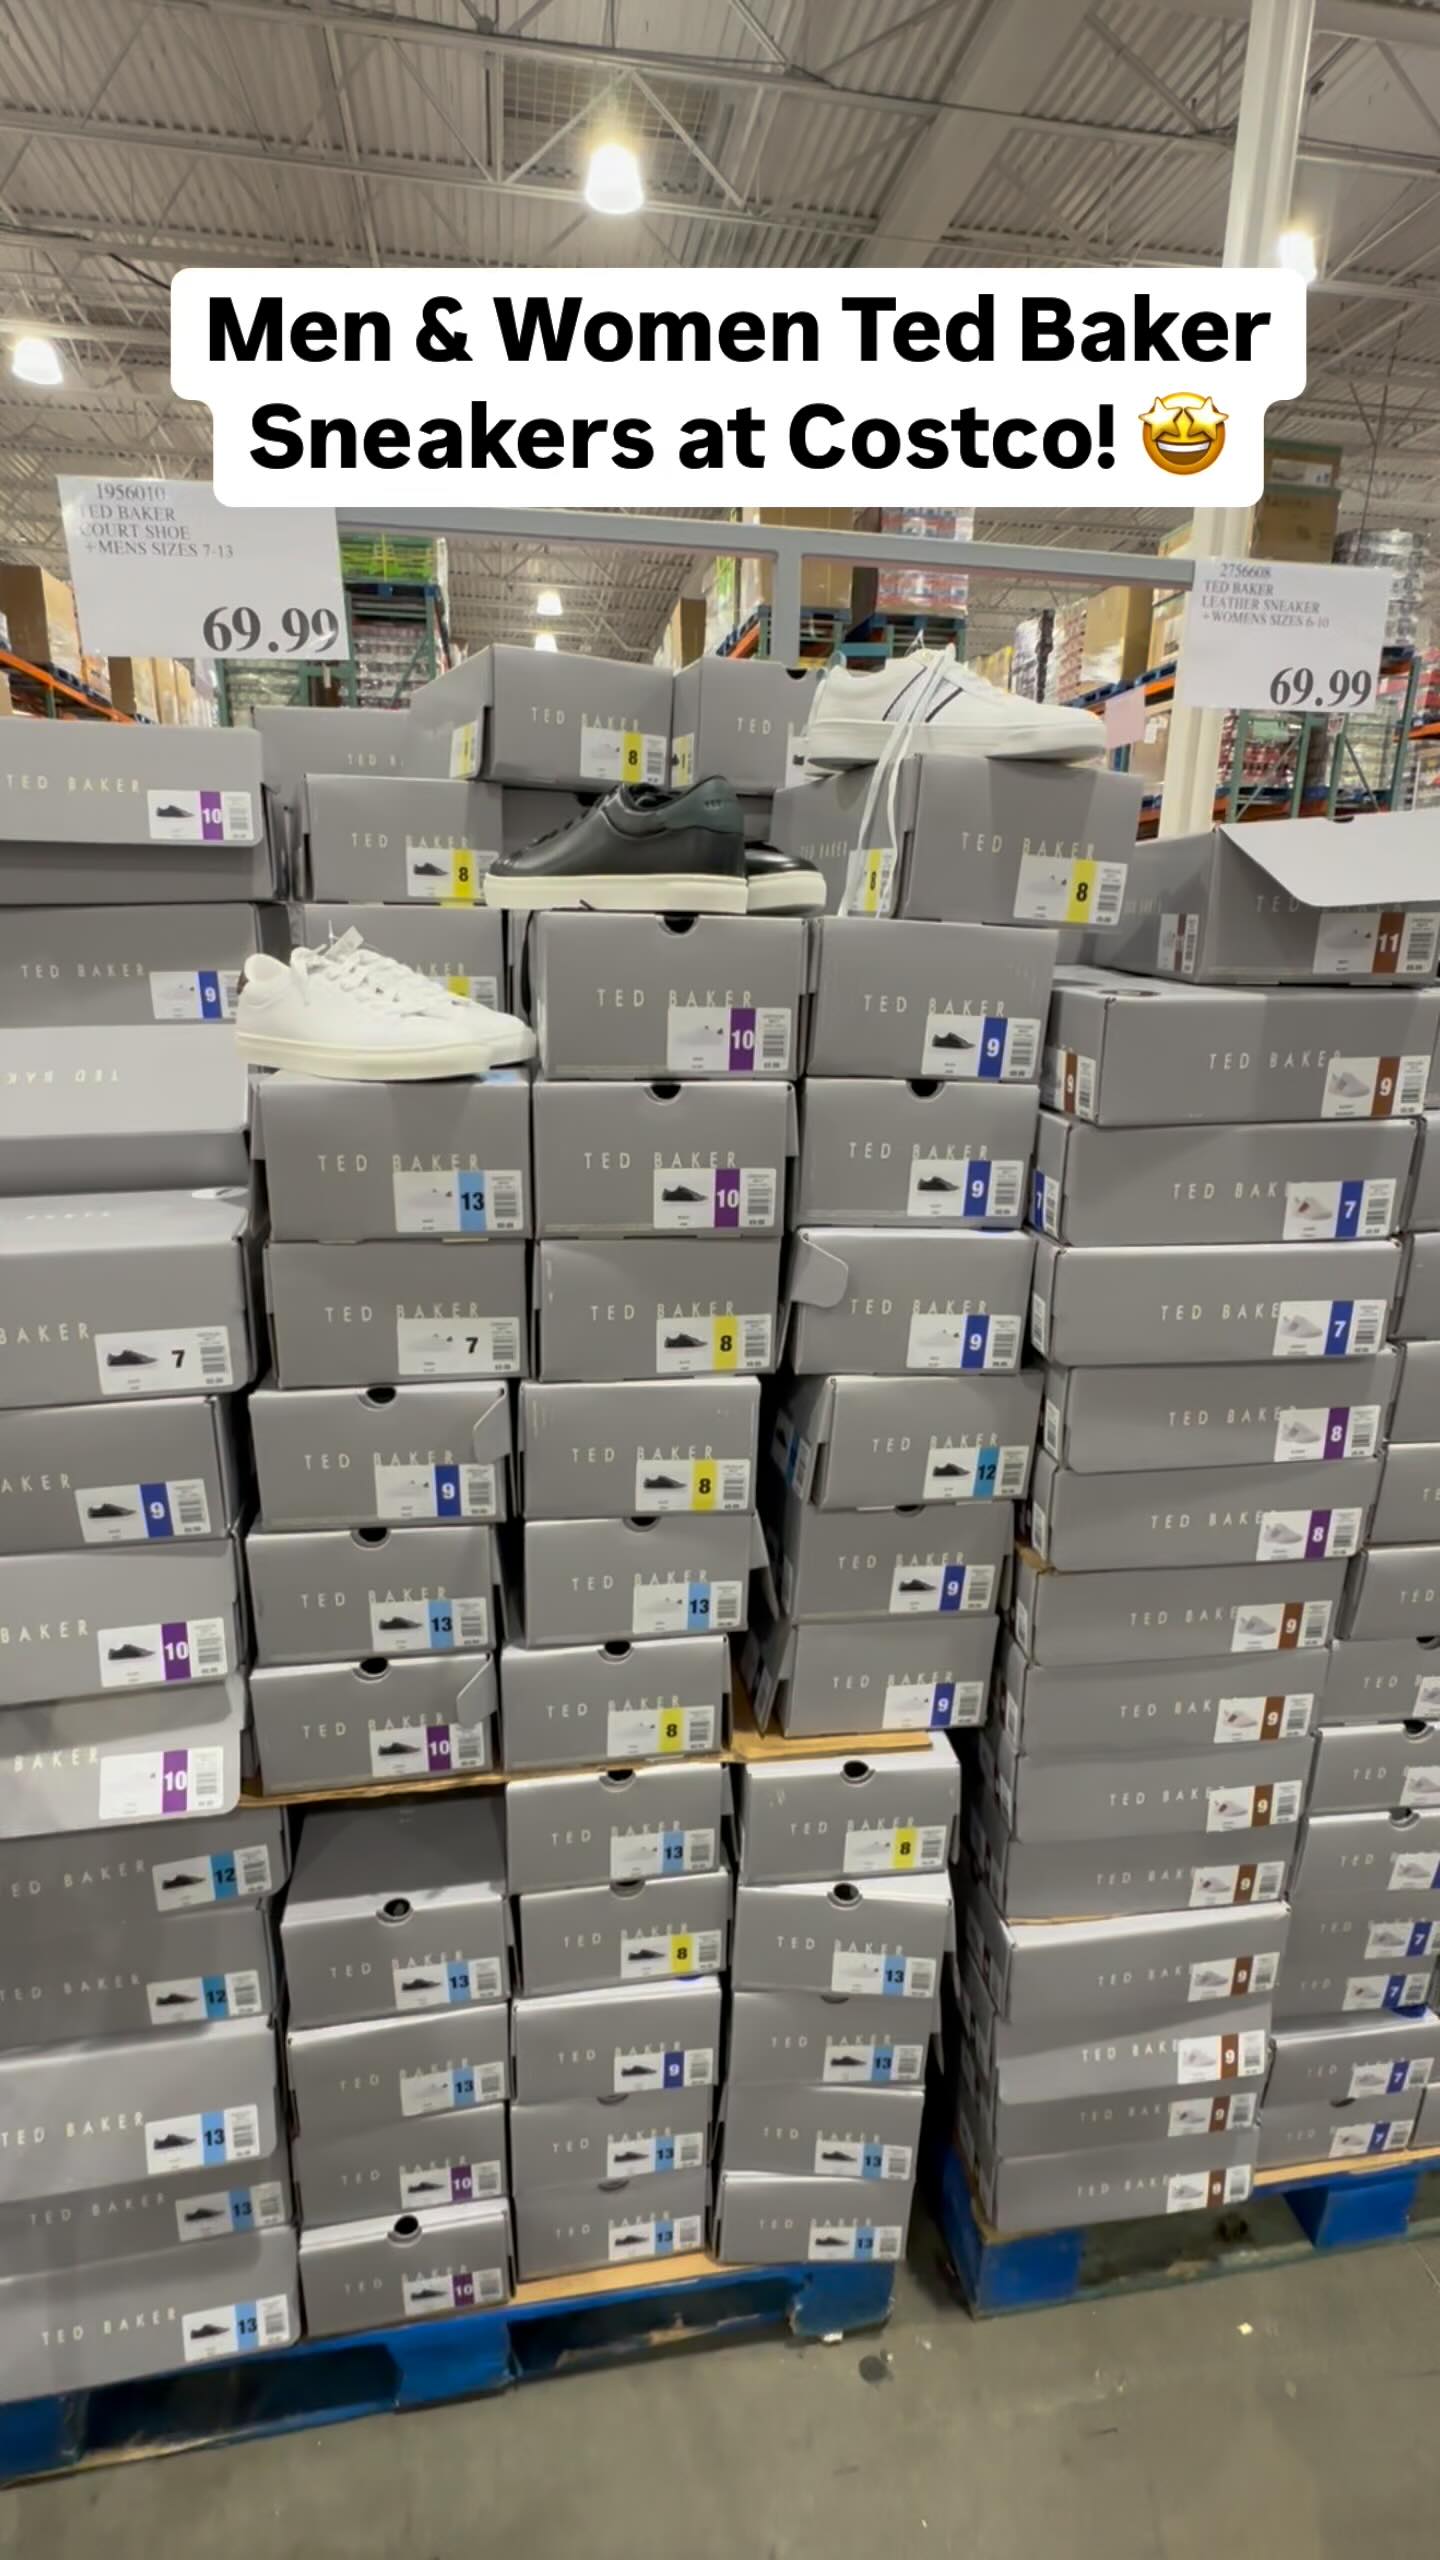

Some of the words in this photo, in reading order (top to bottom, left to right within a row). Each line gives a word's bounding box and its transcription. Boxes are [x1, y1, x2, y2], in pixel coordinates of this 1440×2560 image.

[97, 484, 165, 500] 1956010
[81, 504, 113, 519] TED
[119, 506, 176, 521] BAKER
[81, 522, 141, 538] COURT
[146, 525, 190, 540] SHOE
[151, 543, 198, 557] SIZES
[203, 544, 234, 559] 7-13
[1220, 563, 1271, 579] 2756608
[1204, 580, 1229, 594] TED
[1232, 582, 1273, 596] BAKER
[1202, 595, 1259, 611] LEATHER
[1263, 600, 1320, 614] SNEAKER
[1270, 614, 1303, 627] SIZES
[1305, 615, 1329, 628] 6-10
[203, 606, 338, 653] 69.99
[1270, 667, 1371, 708] 69.99
[531, 707, 565, 725] TED
[736, 717, 771, 735] TED
[627, 750, 638, 766] 8
[7, 774, 48, 790] TED
[68, 776, 140, 793] BAKER
[202, 807, 223, 824] 10
[351, 832, 388, 849] TED
[962, 832, 1002, 853] TED
[458, 866, 469, 882] 8
[1075, 882, 1089, 902] 8
[1377, 933, 1402, 953] 11
[21, 964, 60, 979] TED
[77, 963, 145, 978] BAKER
[204, 986, 217, 1002] 9
[597, 989, 645, 1008] TED
[669, 989, 752, 1008] BAKER
[864, 994, 908, 1014] TED
[731, 1029, 755, 1050] 10
[986, 1037, 1000, 1057] 9
[1209, 1053, 1249, 1070] TED
[1380, 1078, 1393, 1096] 9
[849, 1142, 891, 1159] TED
[318, 1154, 367, 1172] TED
[393, 1154, 480, 1172] BAKER
[584, 1152, 630, 1169] TED
[654, 1151, 736, 1169] BAKER
[971, 1180, 984, 1198] 9
[1174, 1183, 1215, 1199] TED
[461, 1193, 485, 1211] 13
[716, 1189, 740, 1208] 10
[1343, 1201, 1357, 1218] 7
[325, 1306, 372, 1323] TED
[396, 1302, 479, 1319] BAKER
[591, 1304, 635, 1321] TED
[657, 1301, 735, 1318] BAKER
[850, 1299, 893, 1315] TED
[1161, 1305, 1202, 1321] TED
[1334, 1321, 1347, 1338] 7
[465, 1337, 479, 1354] 7
[719, 1335, 733, 1352] 8
[969, 1333, 983, 1350] 9
[171, 1350, 185, 1369] 7
[1169, 1412, 1208, 1427] TED
[1330, 1426, 1343, 1443] 8
[872, 1438, 911, 1453] TED
[305, 1454, 350, 1470] TED
[572, 1447, 615, 1463] TED
[636, 1445, 714, 1461] BAKER
[977, 1464, 997, 1480] 12
[442, 1483, 455, 1500] 9
[698, 1478, 711, 1494] 8
[151, 1502, 164, 1519] 9
[1151, 1514, 1190, 1529] TED
[1312, 1526, 1324, 1542] 8
[838, 1554, 877, 1570] TED
[572, 1575, 614, 1591] TED
[947, 1581, 959, 1596] 9
[301, 1592, 346, 1609] TED
[690, 1598, 709, 1614] 13
[431, 1616, 453, 1632] 13
[1130, 1611, 1168, 1627] TED
[1285, 1618, 1297, 1634] 9
[1, 1619, 88, 1644] BAKER
[164, 1641, 189, 1661] 10
[833, 1674, 870, 1689] TED
[1364, 1676, 1397, 1689] TED
[547, 1703, 588, 1719] TED
[938, 1697, 949, 1711] 9
[1120, 1704, 1157, 1719] TED
[1267, 1712, 1279, 1727] 9
[303, 1721, 347, 1739] TED
[666, 1723, 678, 1738] 8
[429, 1740, 450, 1755] 10
[14, 1746, 98, 1772] BAKER
[164, 1770, 188, 1791] 10
[1353, 1767, 1386, 1781] TED
[1110, 1792, 1145, 1807] TED
[1257, 1799, 1268, 1815] 9
[791, 1821, 828, 1835] TED
[552, 1829, 591, 1846] TED
[665, 1845, 684, 1860] 13
[899, 1841, 911, 1855] 8
[64, 1859, 145, 1888] BAKER
[215, 1867, 236, 1884] 12
[1097, 1871, 1132, 1886] TED
[1240, 1877, 1251, 1892] 9
[564, 1933, 602, 1948] TED
[777, 1936, 816, 1950] TED
[1415, 1934, 1425, 1946] 7
[676, 1947, 688, 1960] 8
[330, 1962, 371, 1979] TED
[885, 1969, 904, 1983] 13
[1237, 1970, 1248, 1983] 9
[64, 1973, 140, 1995] BAKER
[450, 1973, 469, 1989] 13
[1098, 1973, 1132, 1987] TED
[206, 1989, 227, 2005] 12
[1390, 1985, 1400, 1997] 7
[771, 2037, 808, 2048] TED
[558, 2050, 596, 2064] TED
[1083, 2047, 1116, 2063] TED
[1224, 2049, 1235, 2064] 9
[669, 2063, 680, 2077] 9
[875, 2057, 891, 2070] 13
[340, 2075, 379, 2092] TED
[1394, 2072, 1403, 2084] 7
[456, 2080, 473, 2094] 13
[1, 2127, 45, 2147] TED
[66, 2111, 144, 2138] BAKER
[203, 2128, 225, 2147] 13
[553, 2138, 589, 2153] TED
[657, 2148, 674, 2160] 13
[865, 2155, 881, 2168] 13
[342, 2170, 380, 2185] TED
[453, 2177, 472, 2190] 10
[232, 2200, 252, 2218] 13
[657, 2231, 673, 2243] 13
[857, 2237, 873, 2249] 13
[455, 2282, 473, 2296] 10
[41, 2326, 83, 2345] TED
[104, 2307, 176, 2335] BAKER
[237, 2317, 257, 2335] 13
